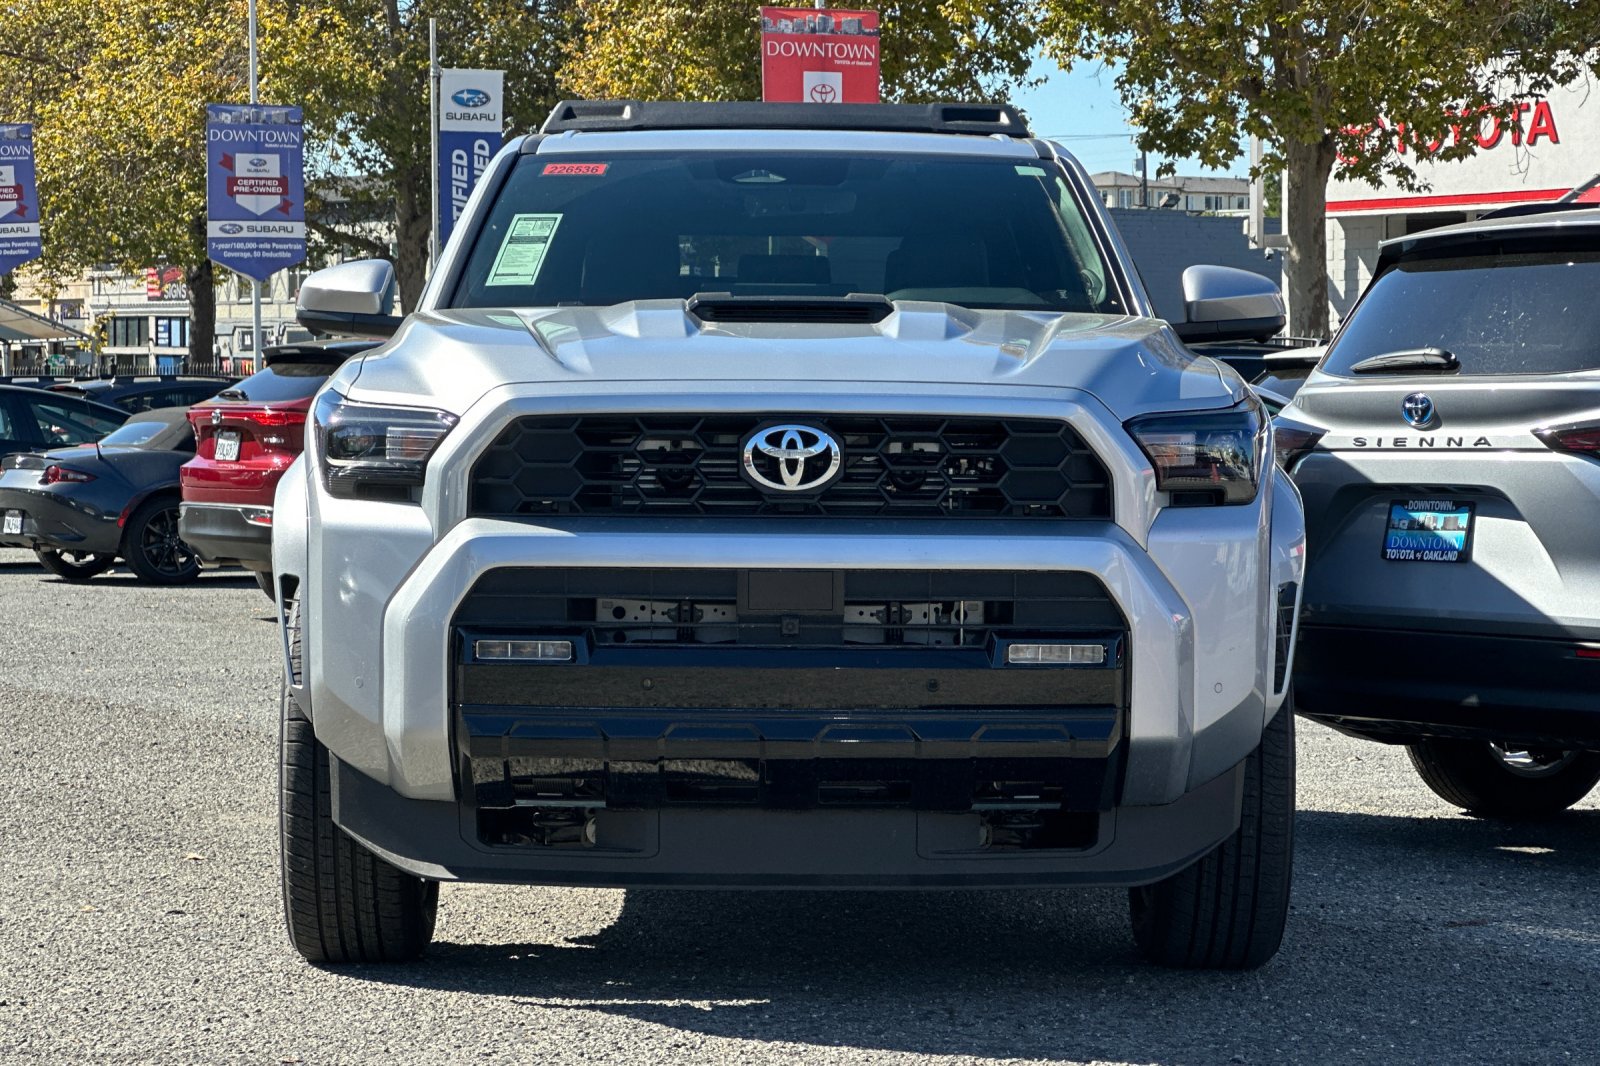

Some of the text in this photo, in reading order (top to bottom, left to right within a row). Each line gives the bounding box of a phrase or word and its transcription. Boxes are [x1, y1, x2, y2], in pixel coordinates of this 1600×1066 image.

[767, 40, 875, 59] DOWNTOWN
[445, 112, 496, 121] SUBARU
[210, 129, 300, 143] DOWNTOWN
[549, 165, 600, 174] 226536
[451, 149, 468, 228] TIFIED
[246, 225, 294, 233] SUBARU
[271, 242, 302, 250] Powertrain
[223, 250, 253, 258] Coverage,
[261, 250, 292, 258] Deductible
[163, 283, 188, 299] SIGNS
[1352, 436, 1492, 447] SIENNA
[1408, 500, 1453, 511] DOWNTOWN
[1391, 535, 1460, 550] DOWNTOWN
[1386, 548, 1458, 561] TOYOTA of OAKLAND
